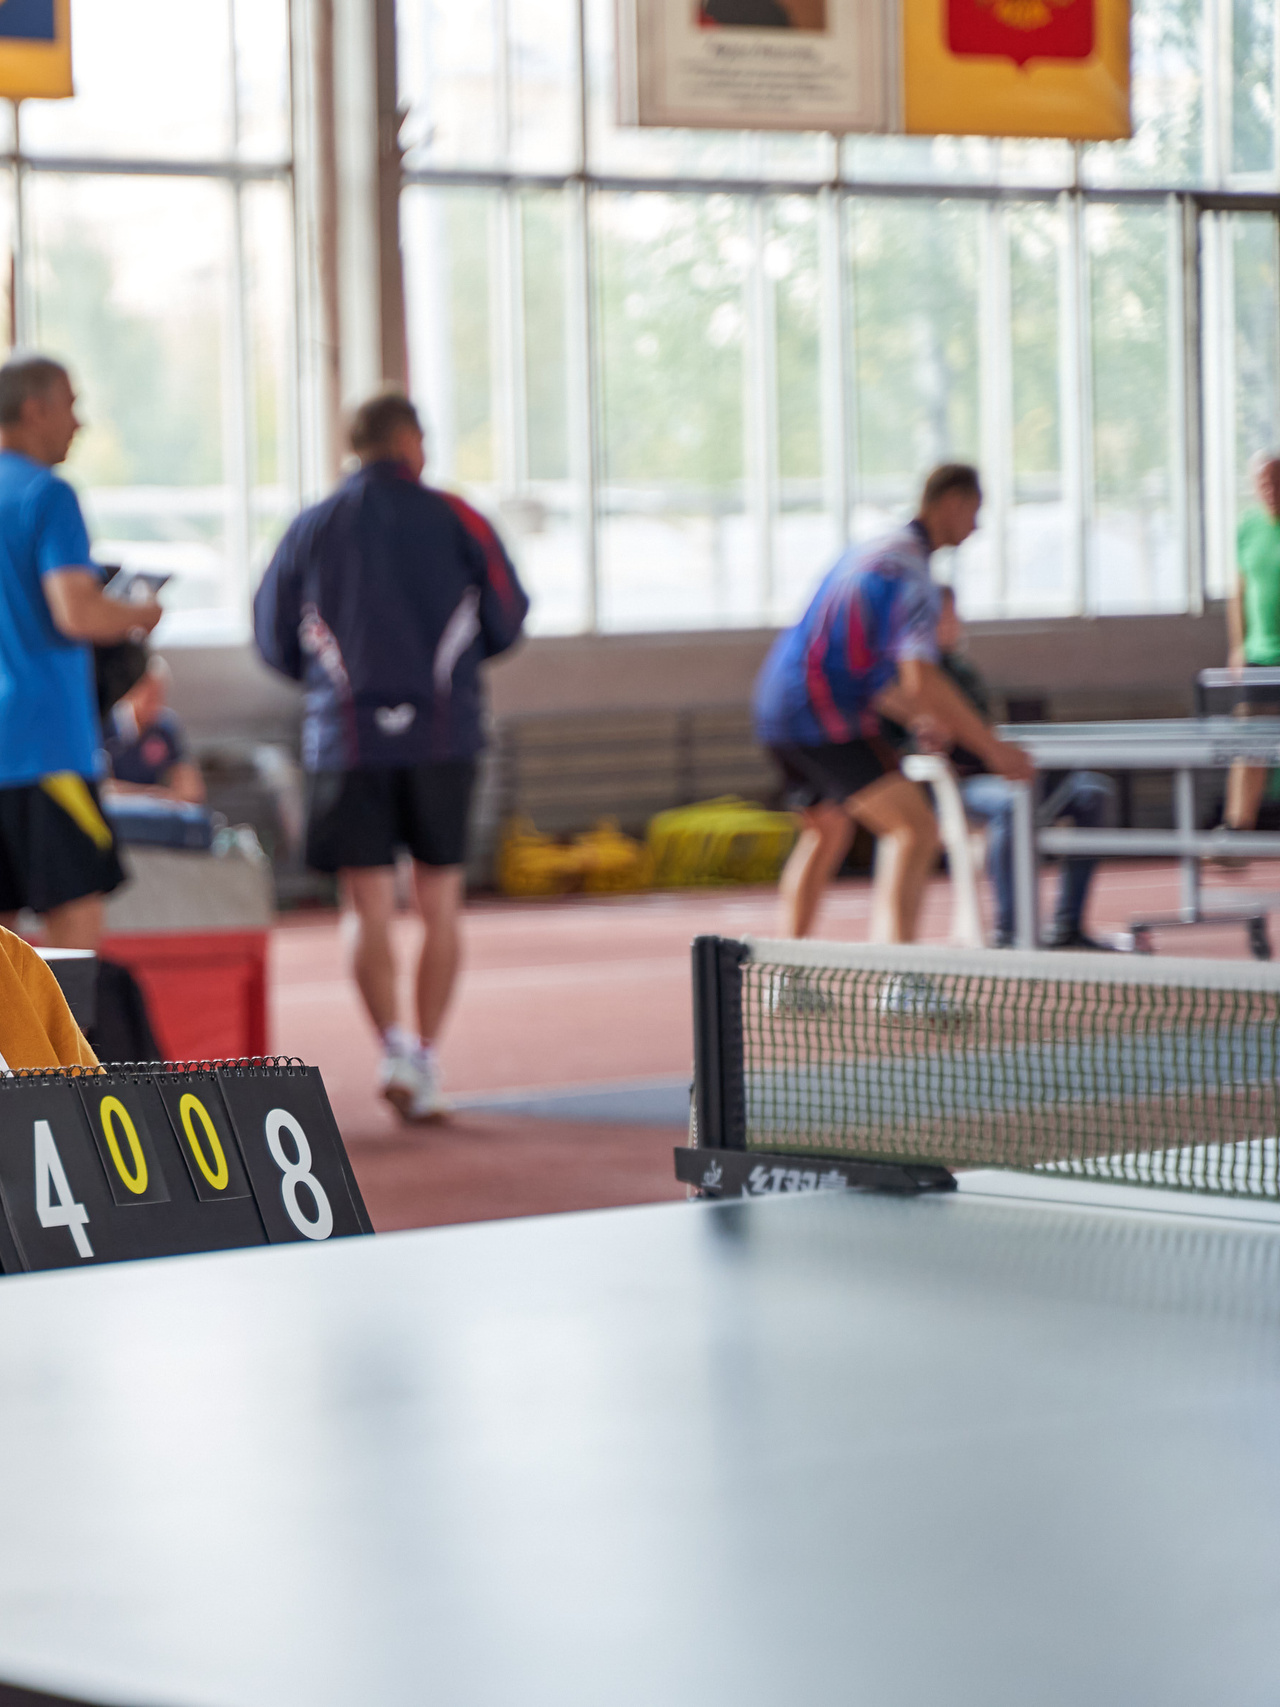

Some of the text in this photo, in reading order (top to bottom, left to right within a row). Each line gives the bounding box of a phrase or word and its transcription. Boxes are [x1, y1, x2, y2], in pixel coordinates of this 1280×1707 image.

[34, 1119, 95, 1258] 4
[100, 1095, 148, 1195] 0
[179, 1093, 229, 1190] 0
[265, 1108, 333, 1241] 8
